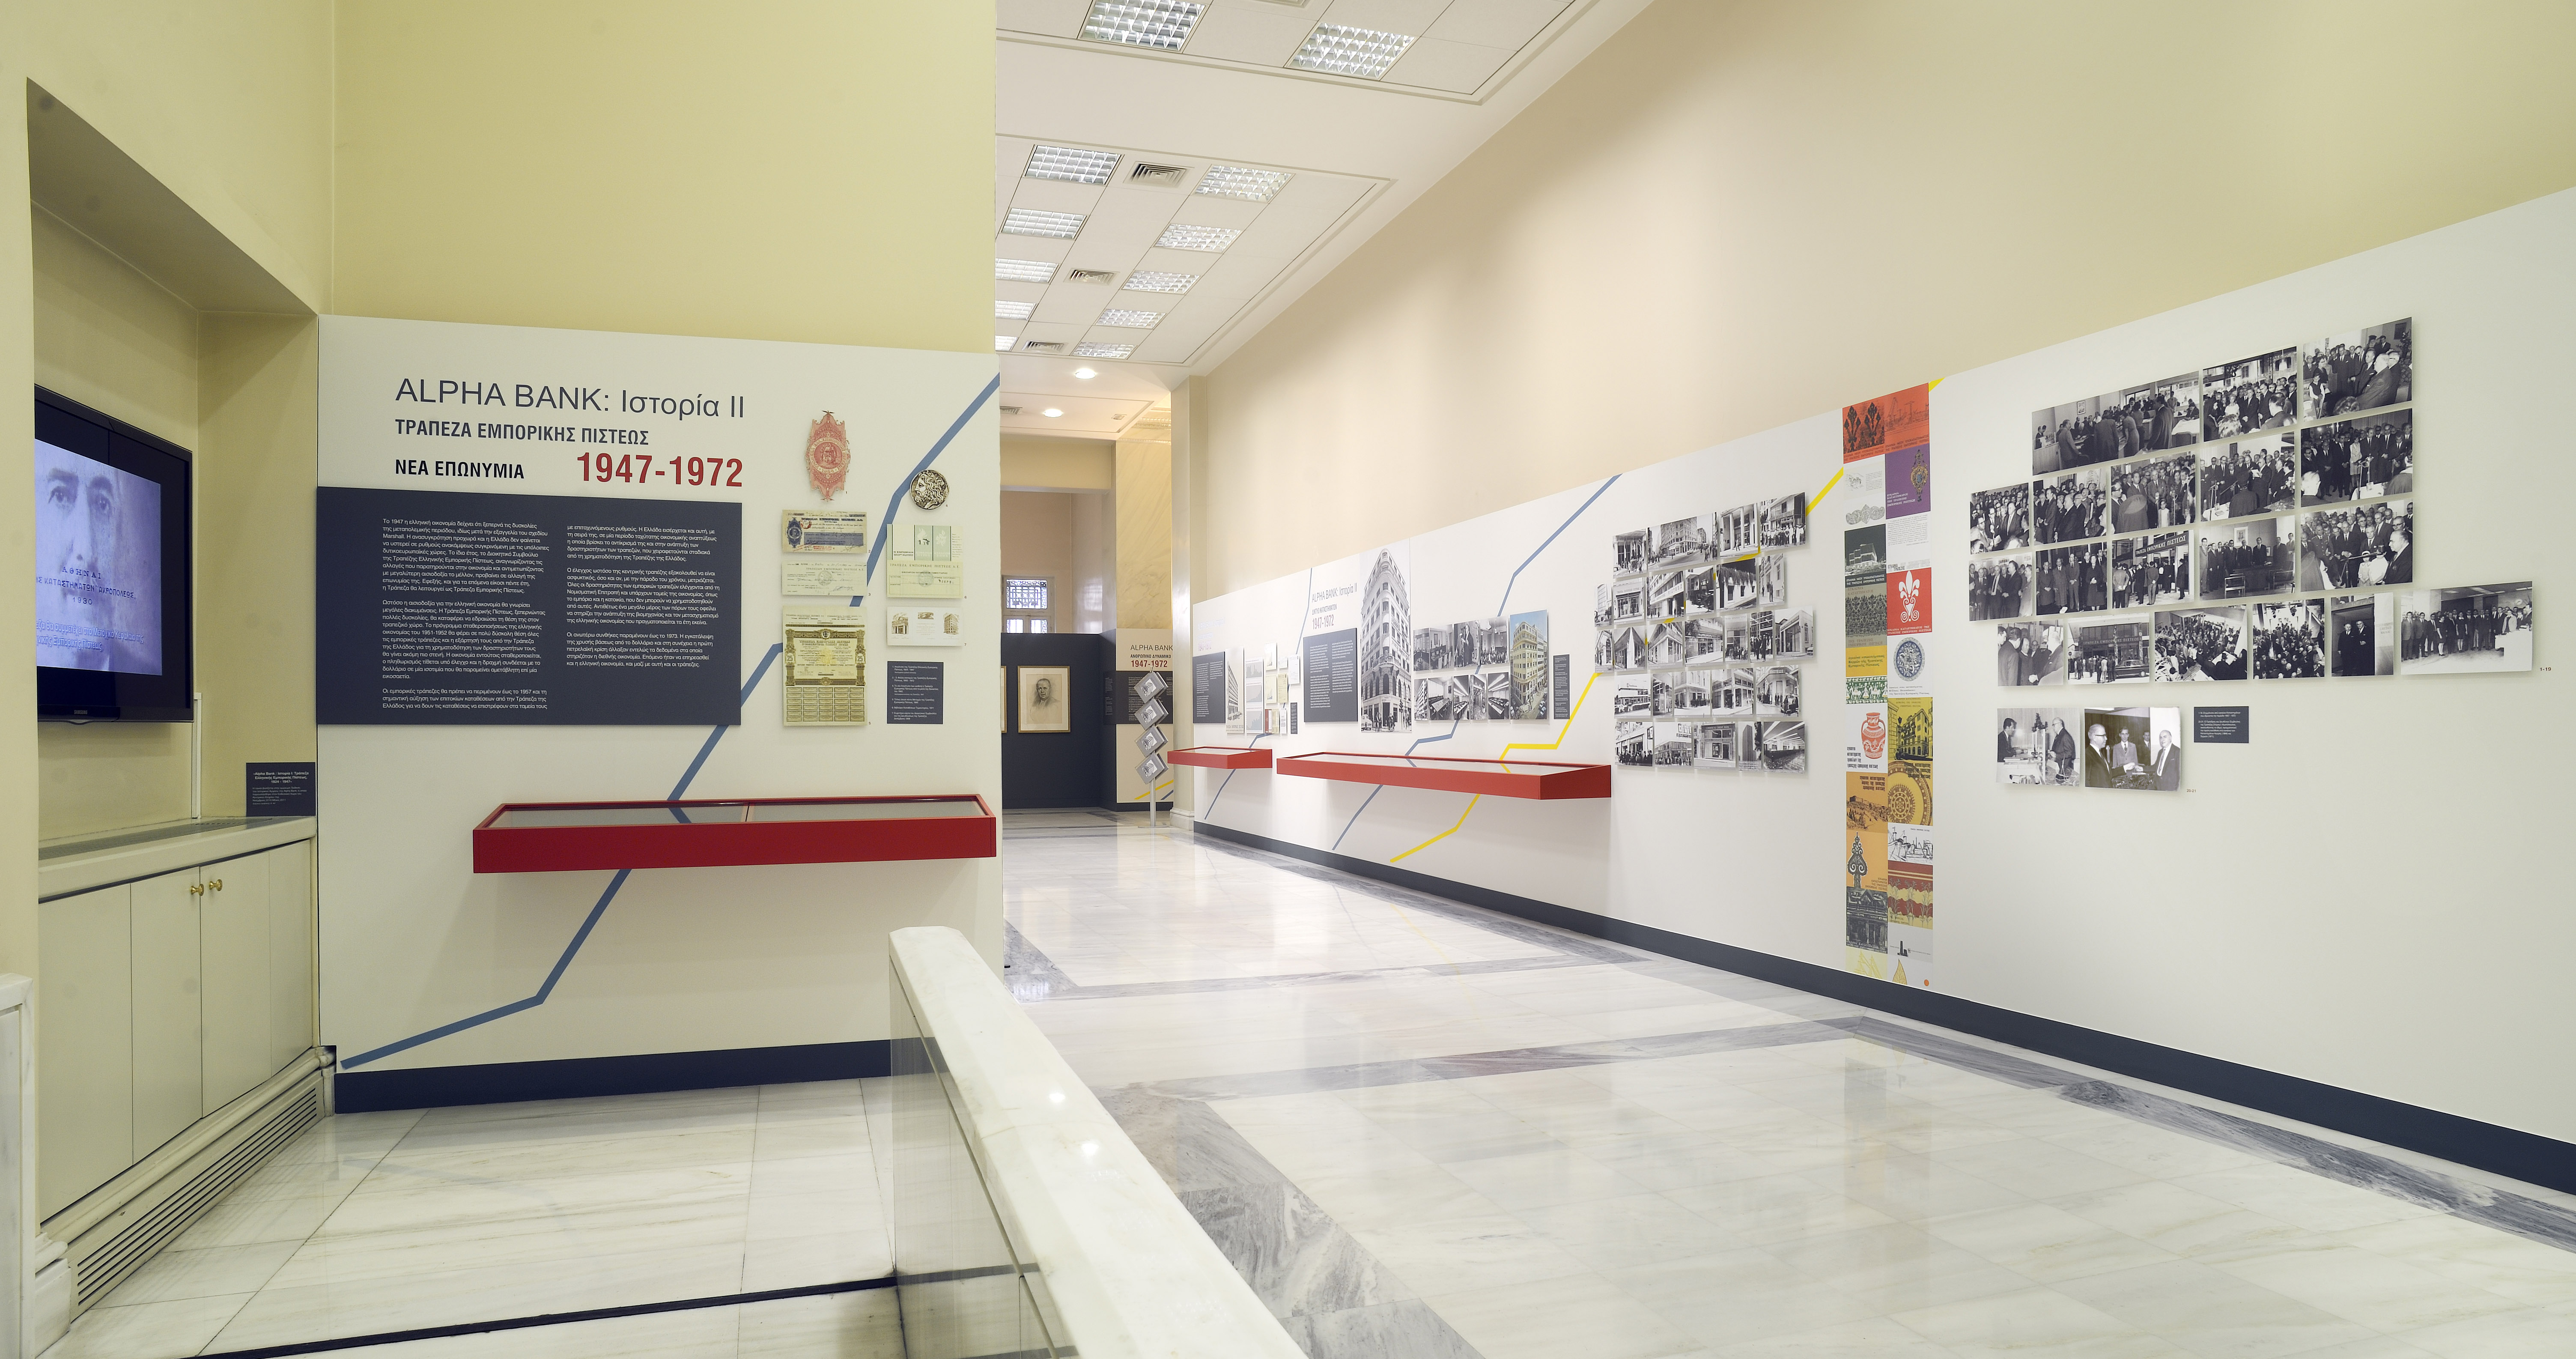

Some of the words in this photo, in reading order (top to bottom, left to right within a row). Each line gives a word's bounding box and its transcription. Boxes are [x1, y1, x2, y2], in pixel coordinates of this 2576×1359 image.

[396, 379, 506, 406] ALPHA
[516, 384, 608, 411] BANK:
[623, 390, 719, 421] Ιστορία
[395, 419, 471, 437] ΤΡΑΠΕΖΑ
[478, 423, 575, 442] ΕΜΠΟΡΙΚΗΣ
[582, 428, 649, 445] ΠΙΣΤΕΩΣ
[396, 459, 429, 475] ΝΕΑ
[435, 461, 524, 479] ΕΠΩΝΥΜΙΑ
[577, 452, 742, 487] 1947-1972
[2167, 535, 2186, 546] ΠΙΣΤΕΩΣ
[62, 567, 101, 579] ΑΘΗΝΑΙ
[45, 578, 94, 591] ΚΑΤΑΣΤΗΜΑΤΩΝ
[1312, 591, 1325, 603] ALPHA
[1339, 584, 1354, 596] Ιστορία
[1312, 614, 1334, 630] 1947-1972
[84, 627, 92, 635] στο
[53, 635, 81, 650] Εμπορικής
